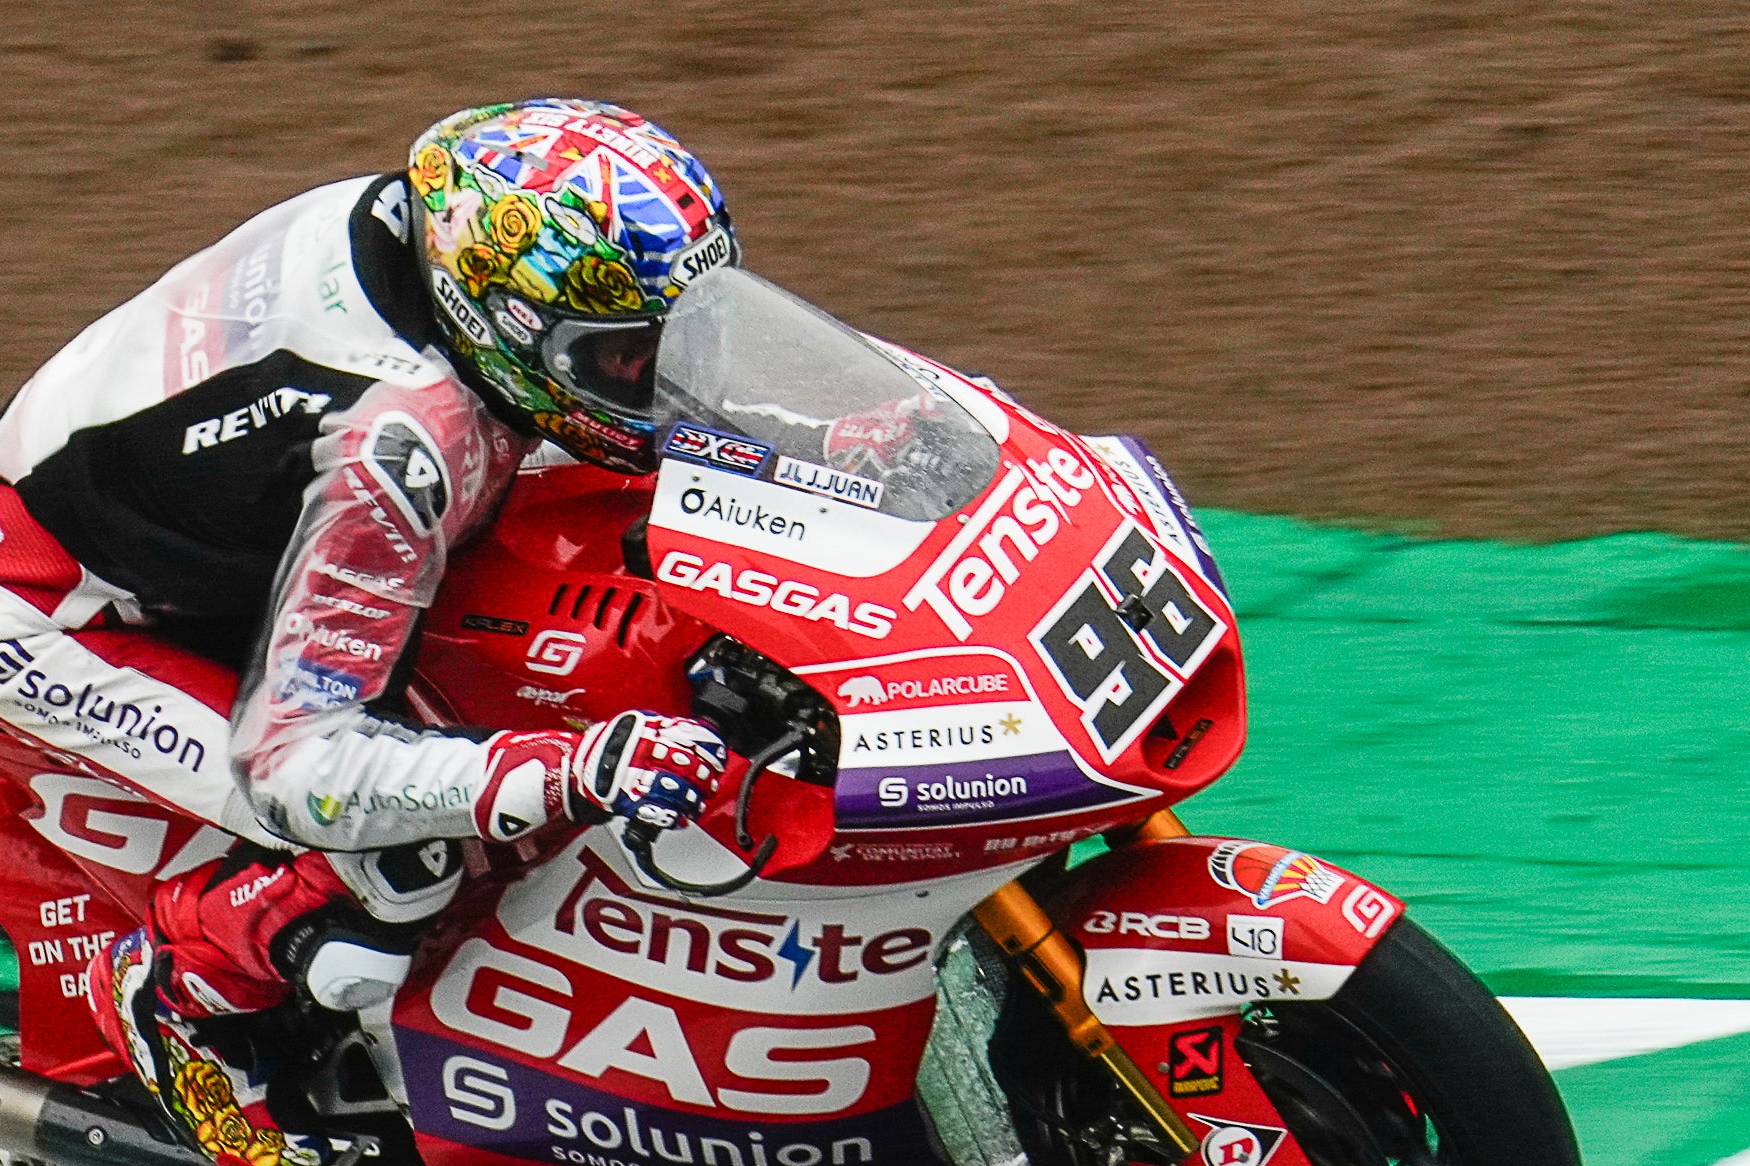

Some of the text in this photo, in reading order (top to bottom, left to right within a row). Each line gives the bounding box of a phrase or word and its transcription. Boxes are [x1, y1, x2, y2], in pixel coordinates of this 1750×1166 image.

[437, 277, 485, 340] SHOEI
[657, 551, 897, 640] GASGAS
[1027, 517, 1228, 766] 96
[887, 673, 1009, 700] POLARCUBE
[18, 670, 206, 773] solunion
[854, 725, 994, 753] ASTERIUS
[916, 773, 1028, 802] solunion
[40, 893, 90, 927] GET
[29, 930, 115, 966] ON THE
[1096, 971, 1271, 1003] ASTERIUS
[430, 937, 876, 1115] GAS
